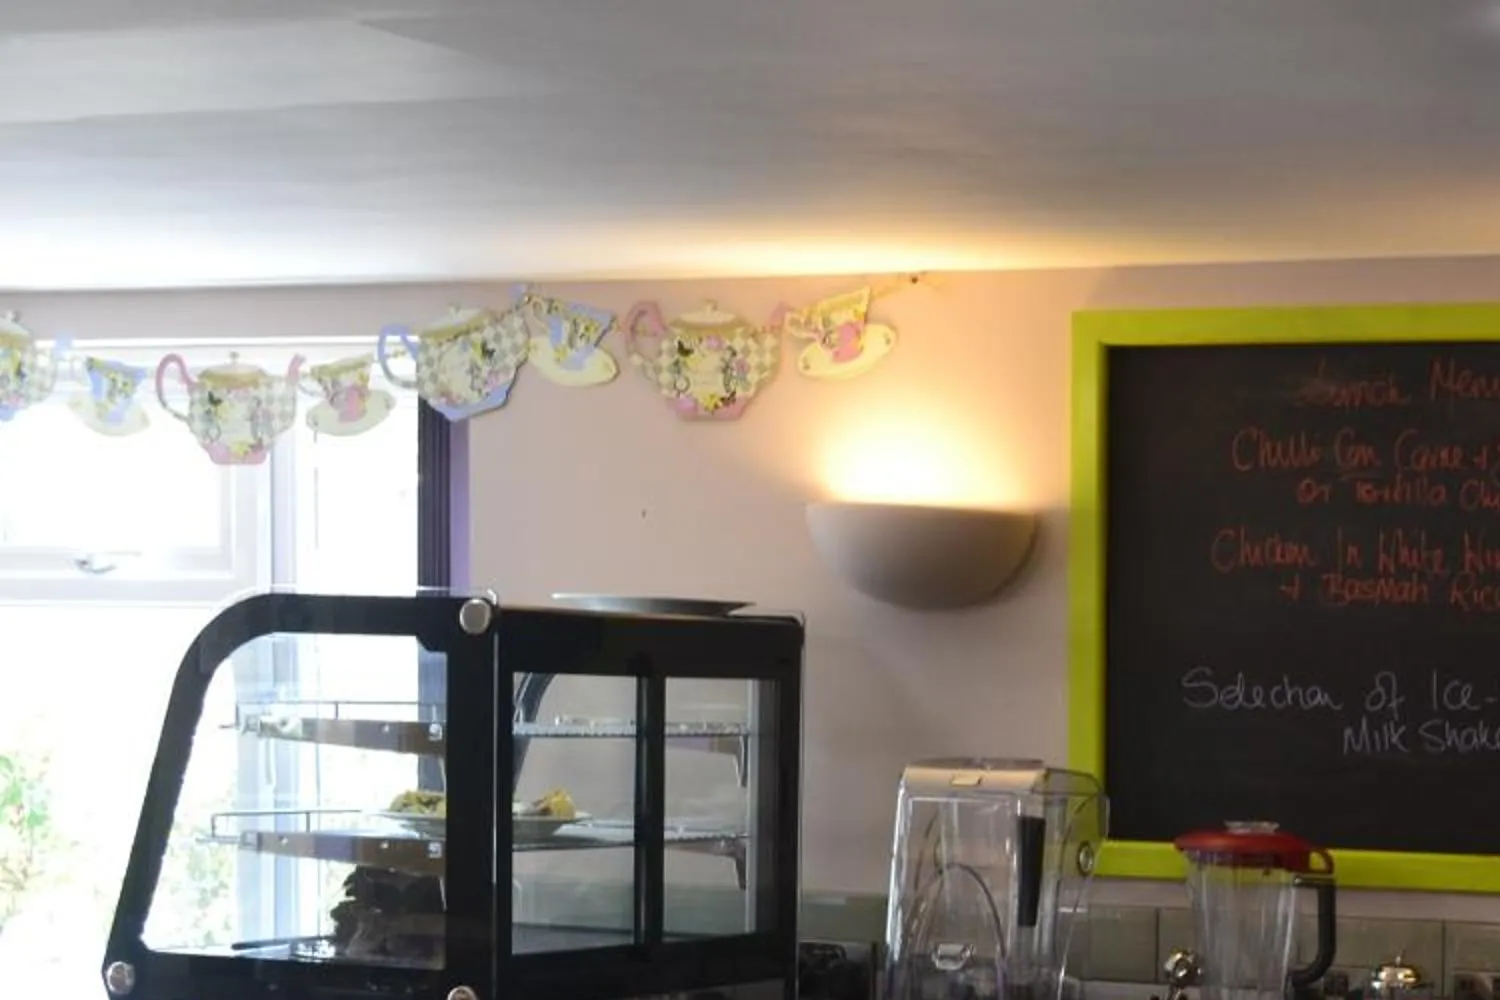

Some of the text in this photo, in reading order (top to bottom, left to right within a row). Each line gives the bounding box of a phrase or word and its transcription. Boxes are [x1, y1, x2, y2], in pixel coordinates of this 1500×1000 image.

[1333, 427, 1381, 470] Con
[1211, 526, 1317, 574] Chicken
[1377, 525, 1449, 580] White
[1180, 664, 1344, 712] Selection
[1364, 669, 1405, 720] of
[1342, 716, 1410, 757] Milk
